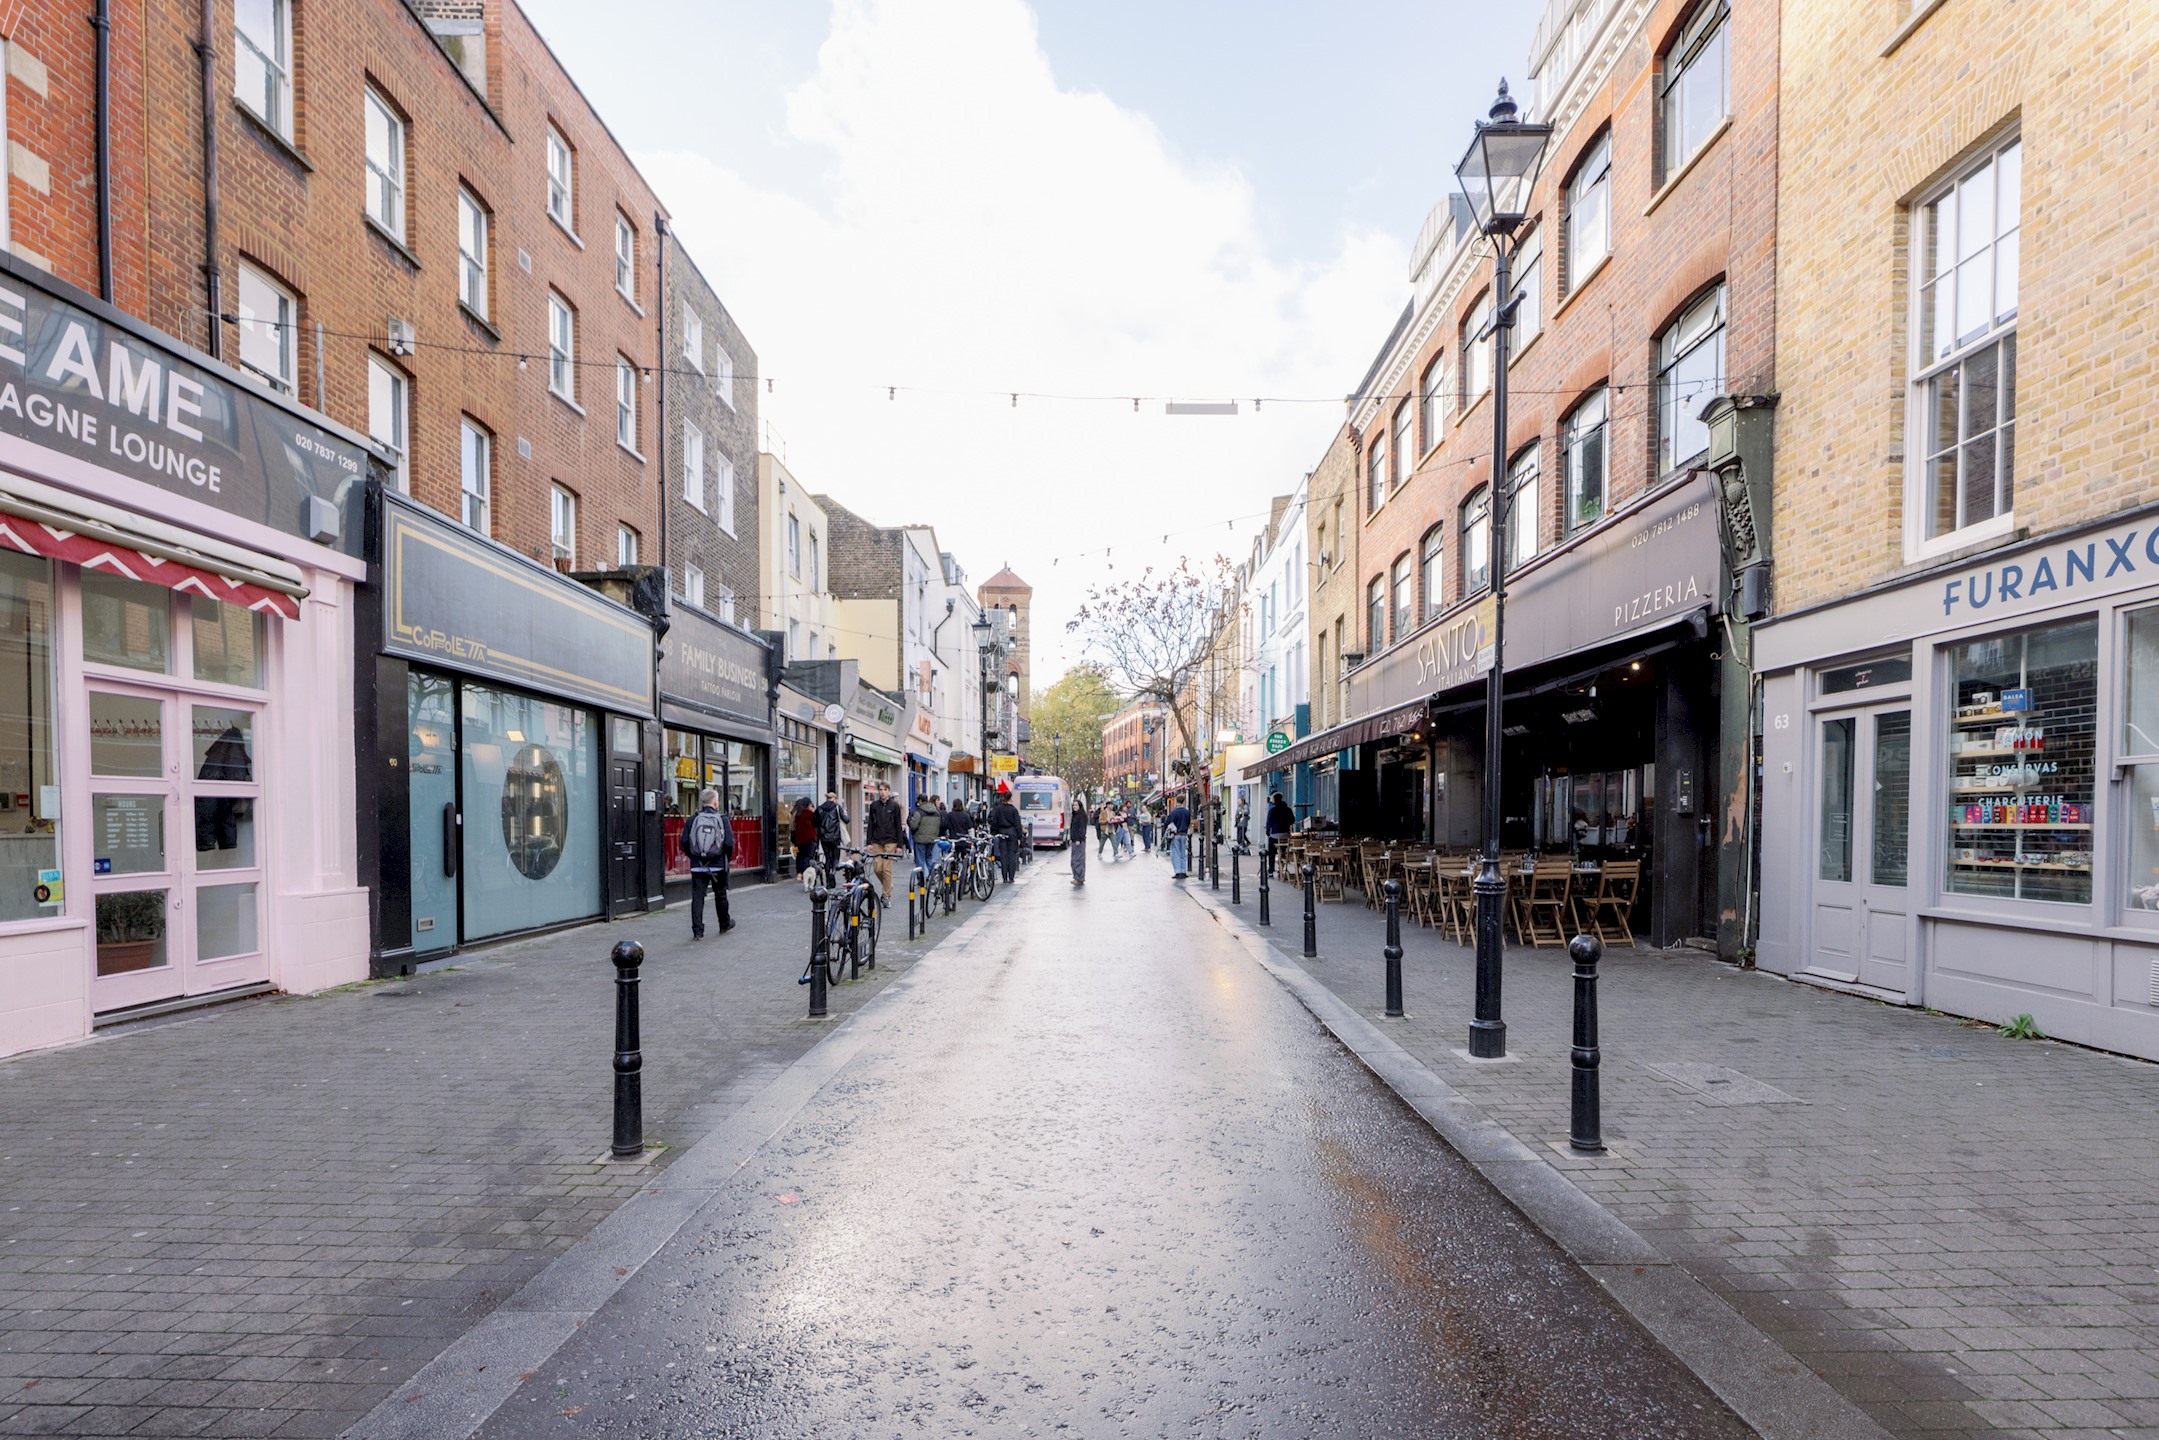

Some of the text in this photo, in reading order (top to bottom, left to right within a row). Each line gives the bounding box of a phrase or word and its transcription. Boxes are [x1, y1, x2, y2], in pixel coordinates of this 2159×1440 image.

[110, 424, 221, 494] LOUNGE
[296, 433, 358, 473] 020 7837 1299
[1631, 503, 1699, 548] 020 7812 1488
[1615, 575, 1698, 627] PIZZERIA
[663, 638, 673, 656] 58
[1417, 614, 1478, 686] SANTO
[681, 642, 757, 690] FAMILY BUSINESS
[1438, 664, 1477, 690] ITALIANO
[701, 680, 720, 696] TATTOO
[1774, 713, 1789, 729] 63
[388, 757, 398, 767] 60
[1985, 761, 2058, 776] CONSERVAS
[1978, 795, 2064, 807] CHARCUTERIE
